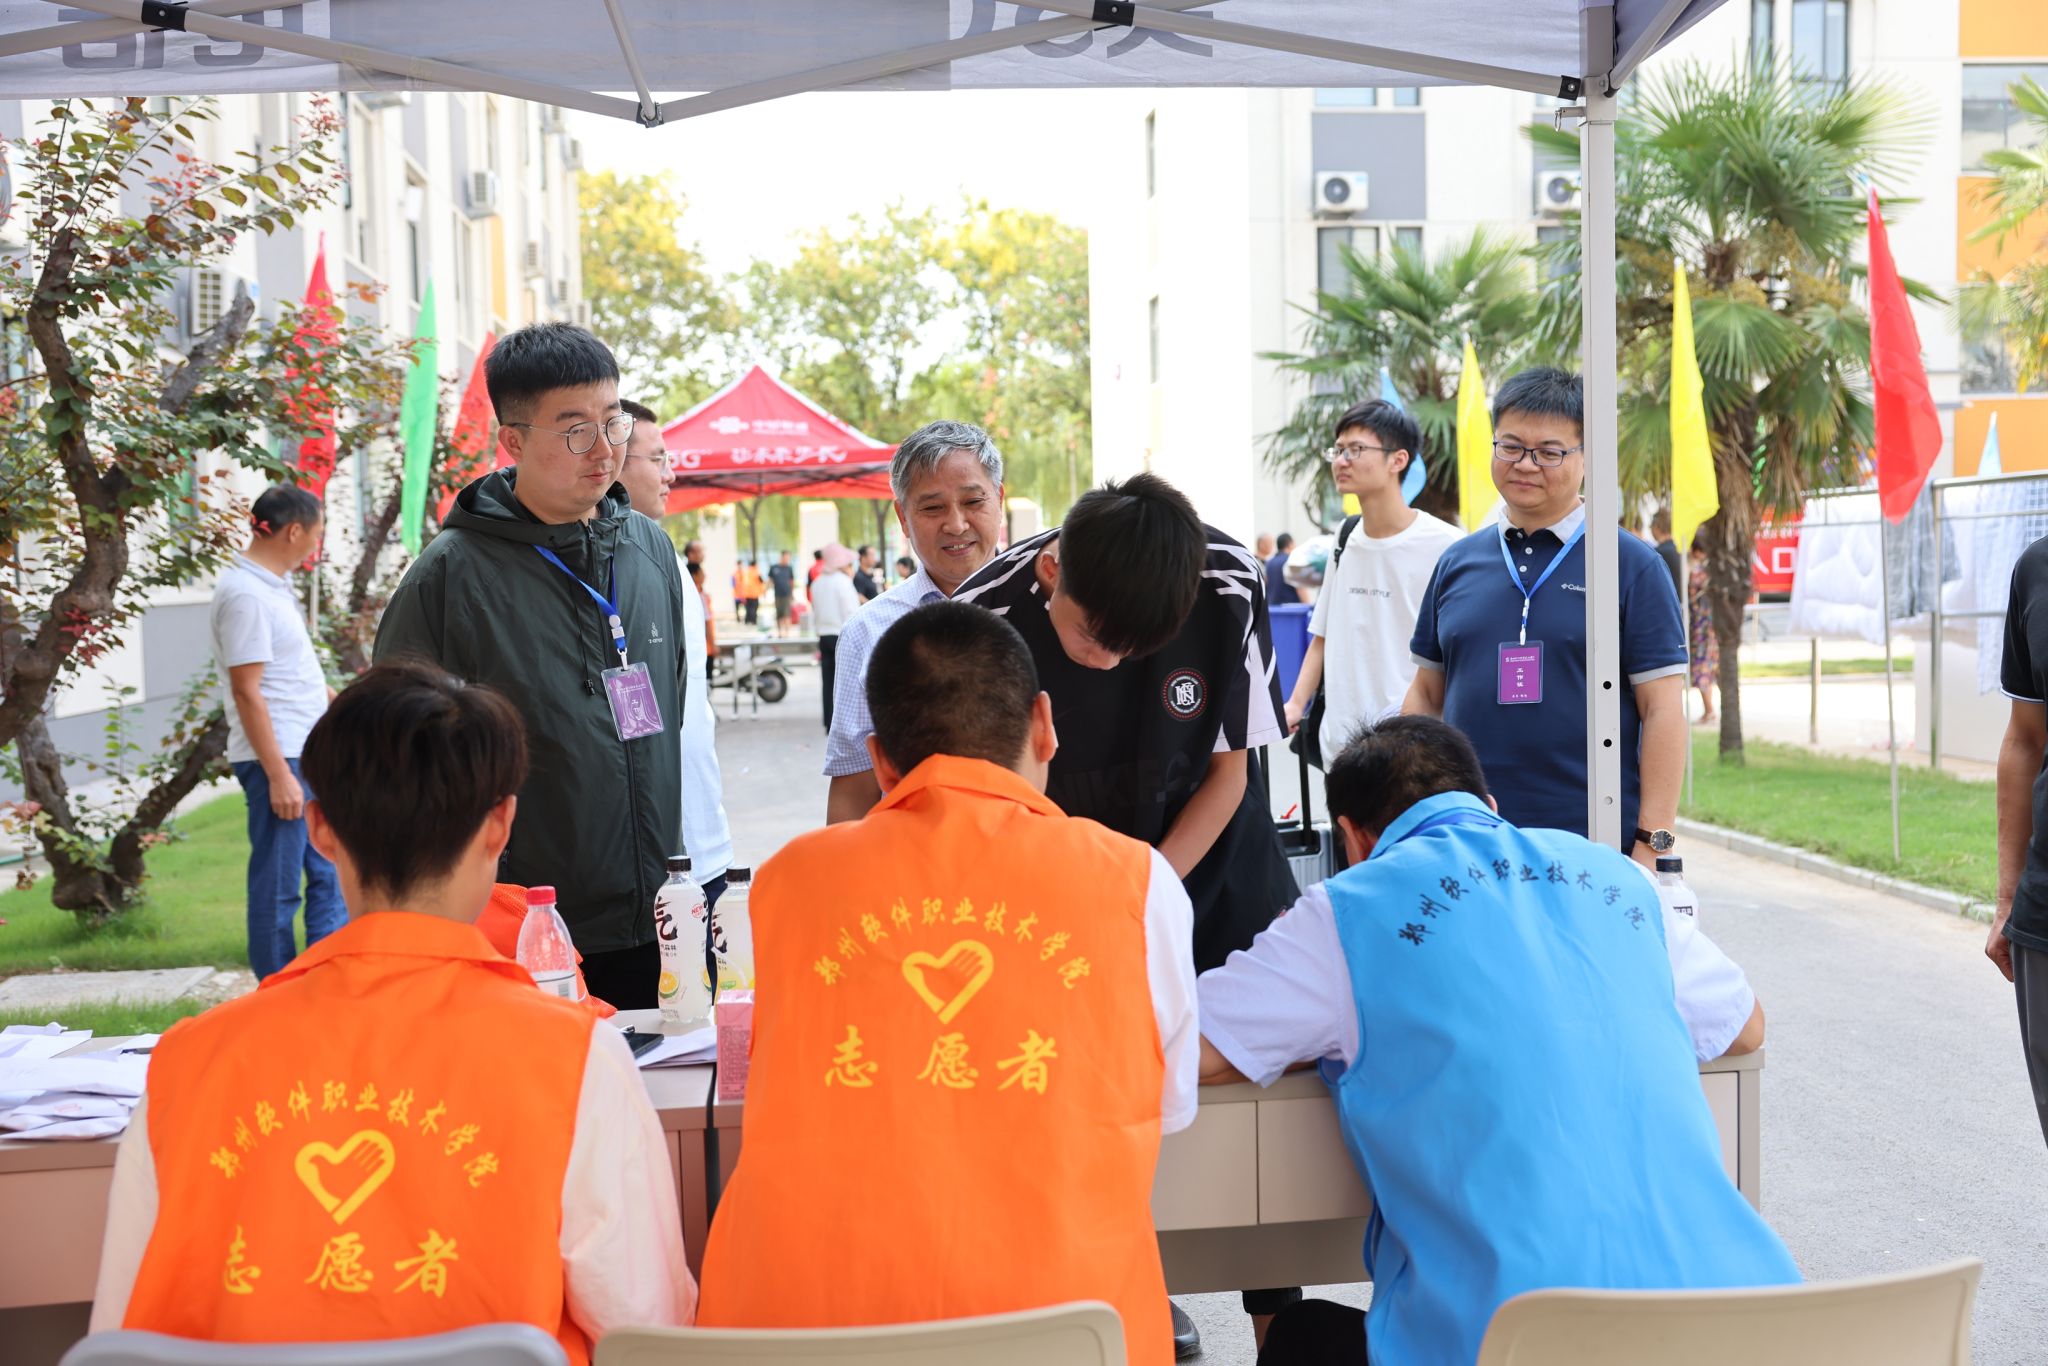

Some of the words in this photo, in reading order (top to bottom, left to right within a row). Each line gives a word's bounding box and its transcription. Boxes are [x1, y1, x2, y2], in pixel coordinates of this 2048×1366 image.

[814, 898, 1092, 990] 郑州软件职业技术学院
[1398, 858, 1645, 946] 郑州软件职业技术学院
[825, 1025, 1058, 1095] 志愿者
[210, 1081, 498, 1188] 郑州软件职业技术学院
[224, 1225, 458, 1297] 志愿者
